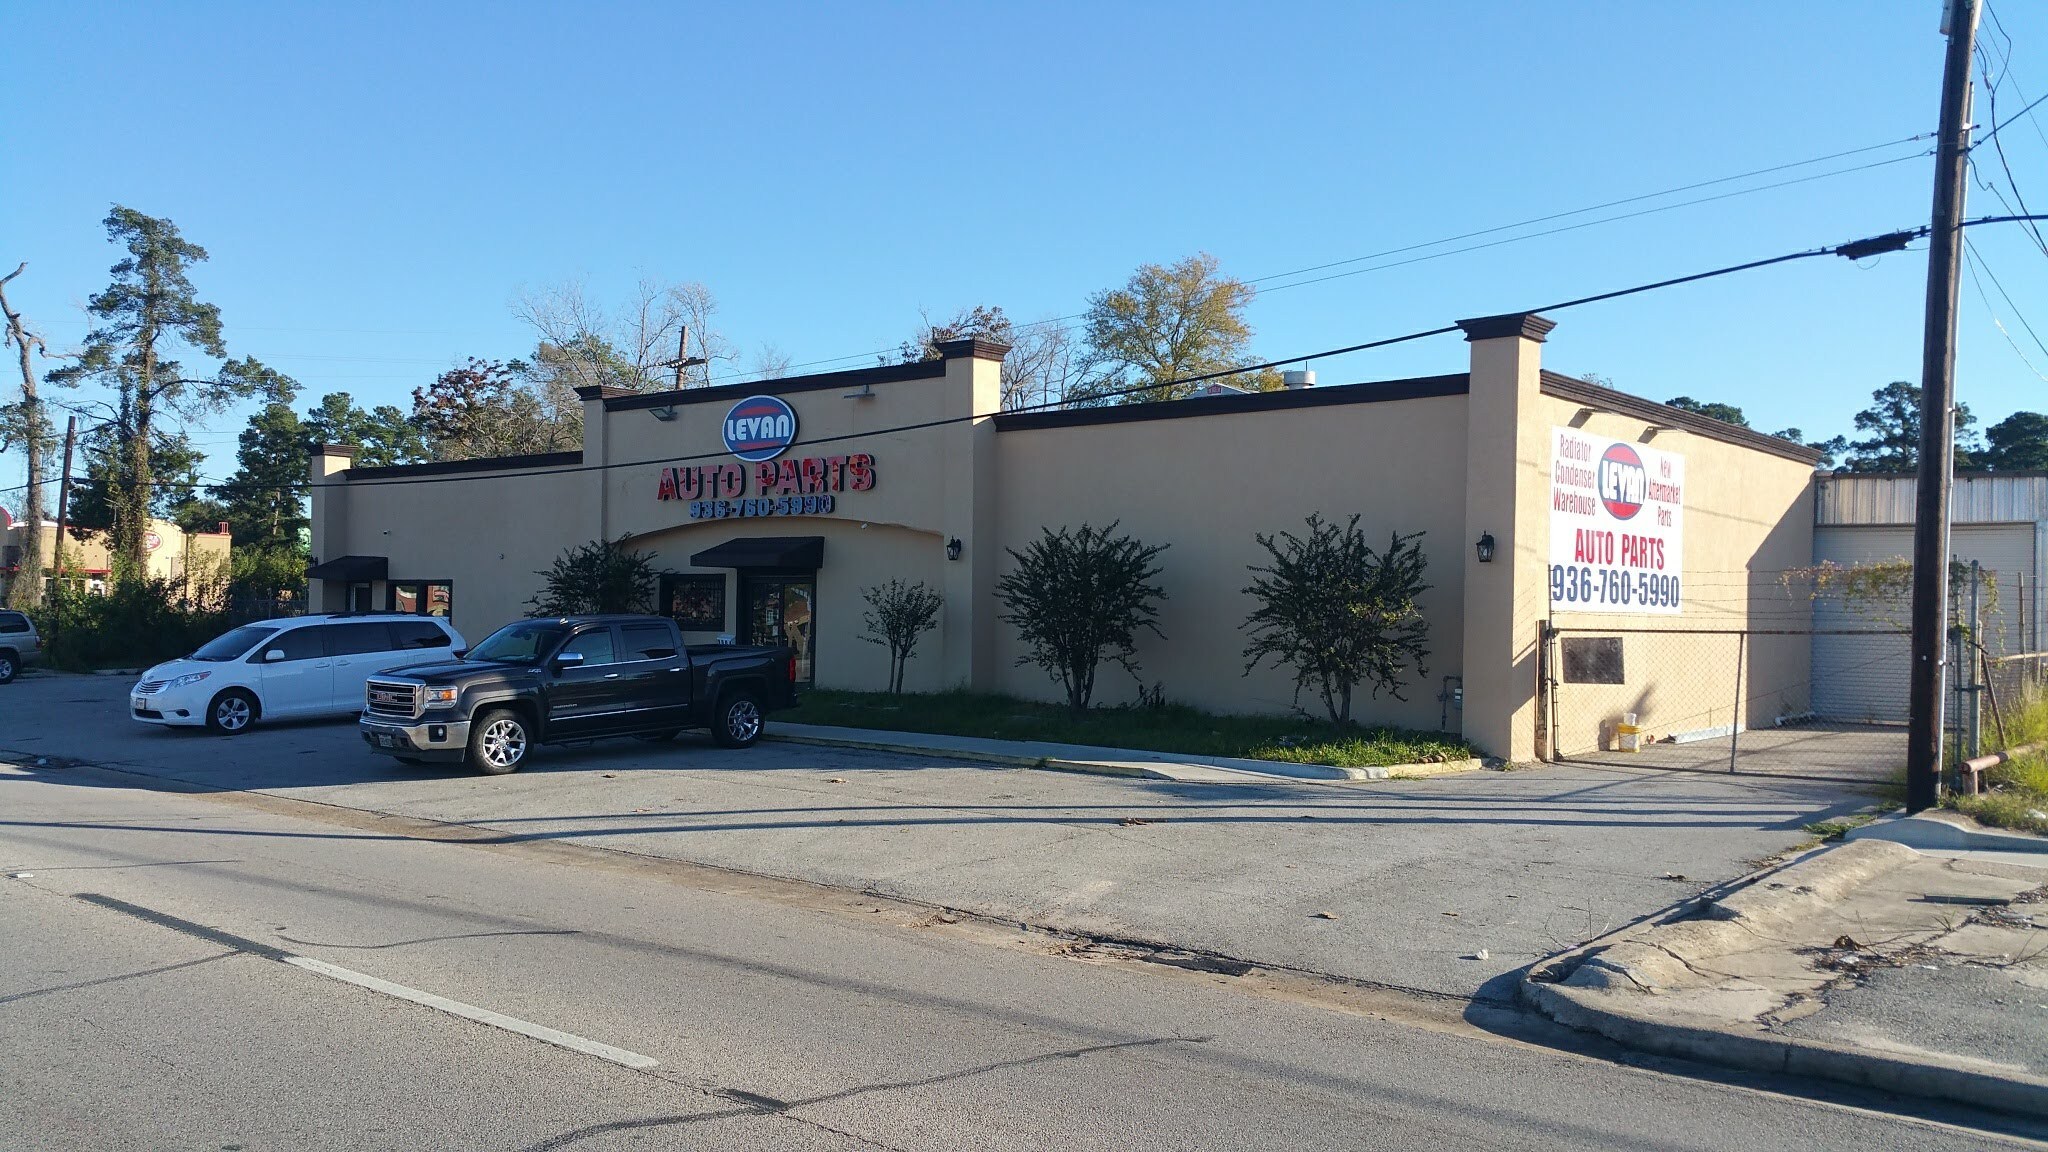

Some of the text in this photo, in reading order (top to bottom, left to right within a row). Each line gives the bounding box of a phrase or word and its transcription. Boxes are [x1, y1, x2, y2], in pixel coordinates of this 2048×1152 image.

[727, 414, 790, 441] LEVAN
[1560, 434, 1591, 462] Radiator
[657, 453, 877, 501] AUTO PARTS
[1555, 460, 1595, 490] Condenser
[1602, 460, 1644, 504] LEVAN
[1660, 456, 1671, 479] New
[1553, 486, 1596, 517] Warehouse
[1648, 477, 1680, 505] Aftermarket
[690, 494, 833, 519] 936-760-5990
[1657, 505, 1671, 527] Parts
[1574, 528, 1665, 570] AUTO PARTS
[1552, 564, 1680, 607] 936-760-5990
